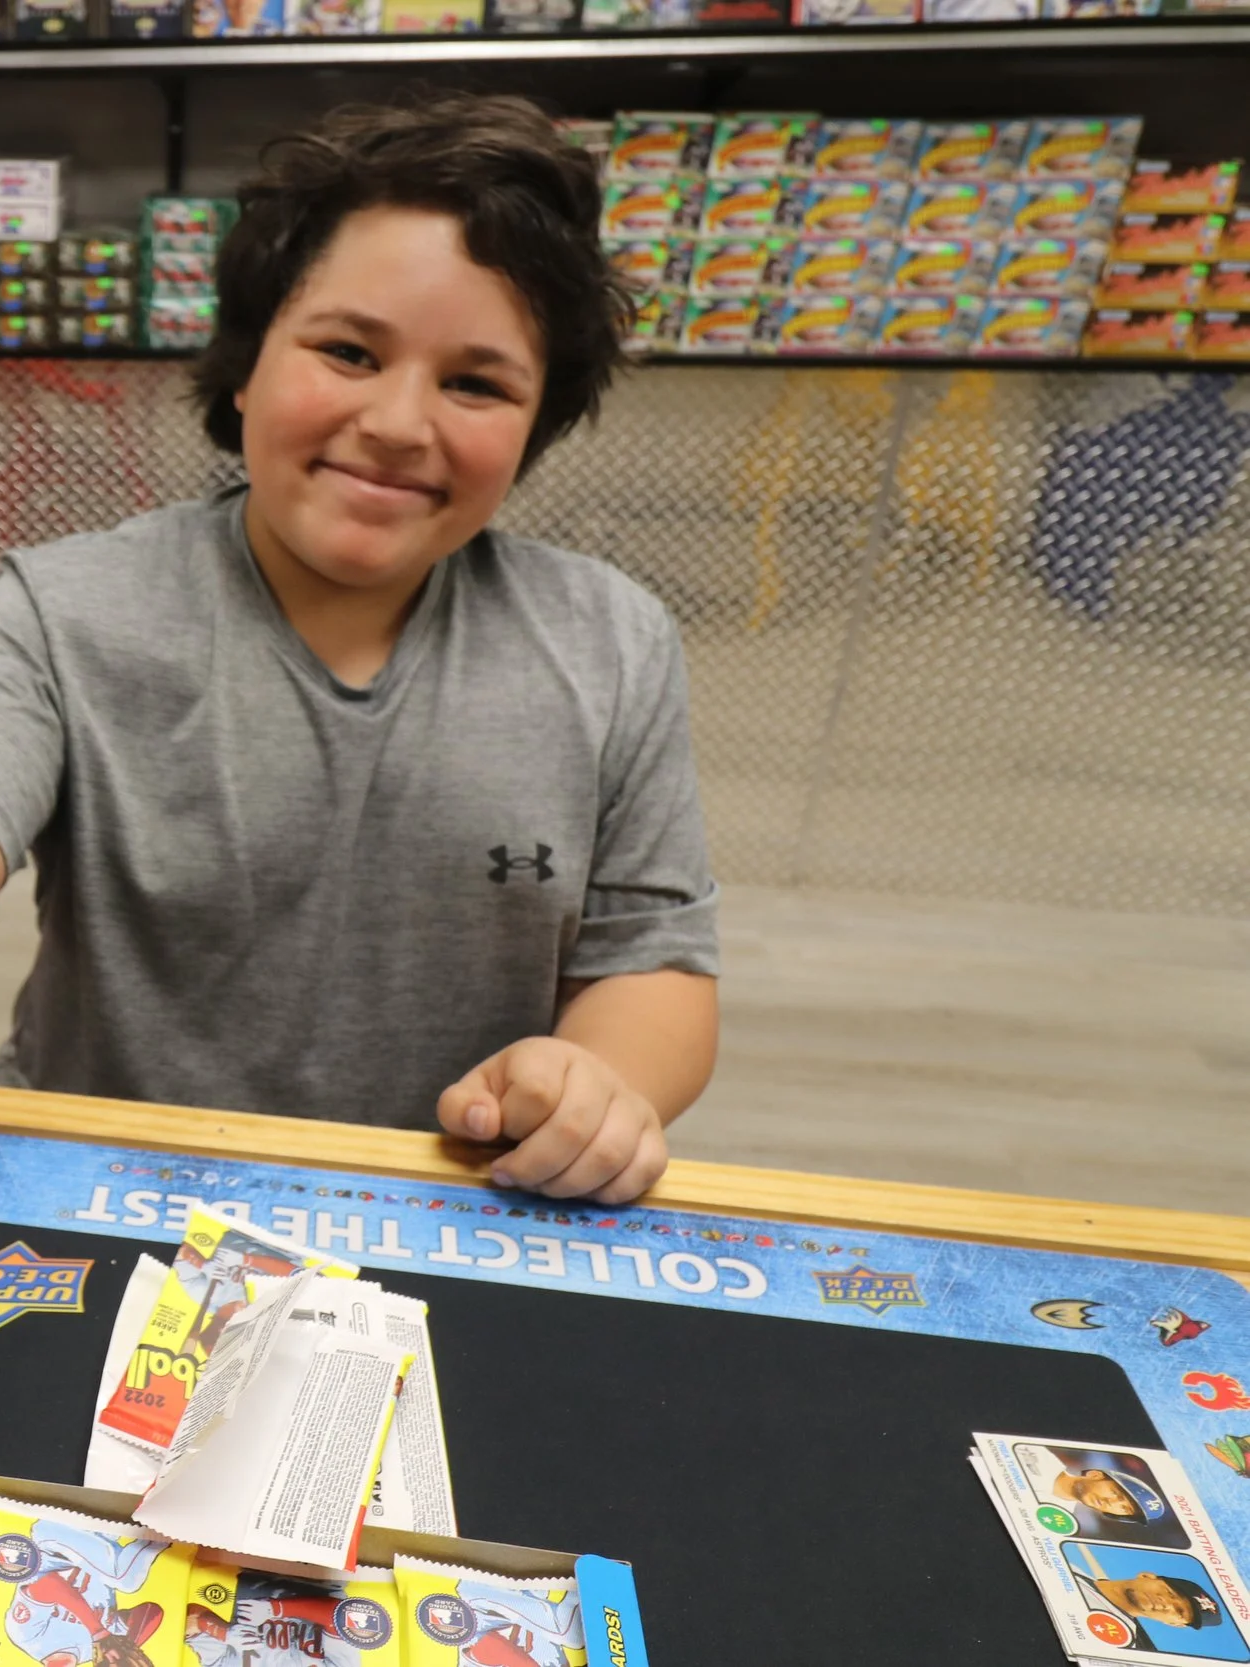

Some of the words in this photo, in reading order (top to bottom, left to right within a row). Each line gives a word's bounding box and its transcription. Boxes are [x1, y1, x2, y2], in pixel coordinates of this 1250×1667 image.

[271, 1206, 413, 1258] THE
[427, 1225, 768, 1300] COLLECT
[828, 1288, 915, 1301] UPPER
[123, 1388, 166, 1408] 2022
[1174, 1494, 1194, 1517] 2021
[1188, 1519, 1222, 1566] BATTING
[1215, 1567, 1250, 1620] LEADERS
[603, 1606, 628, 1667] ARDS!
